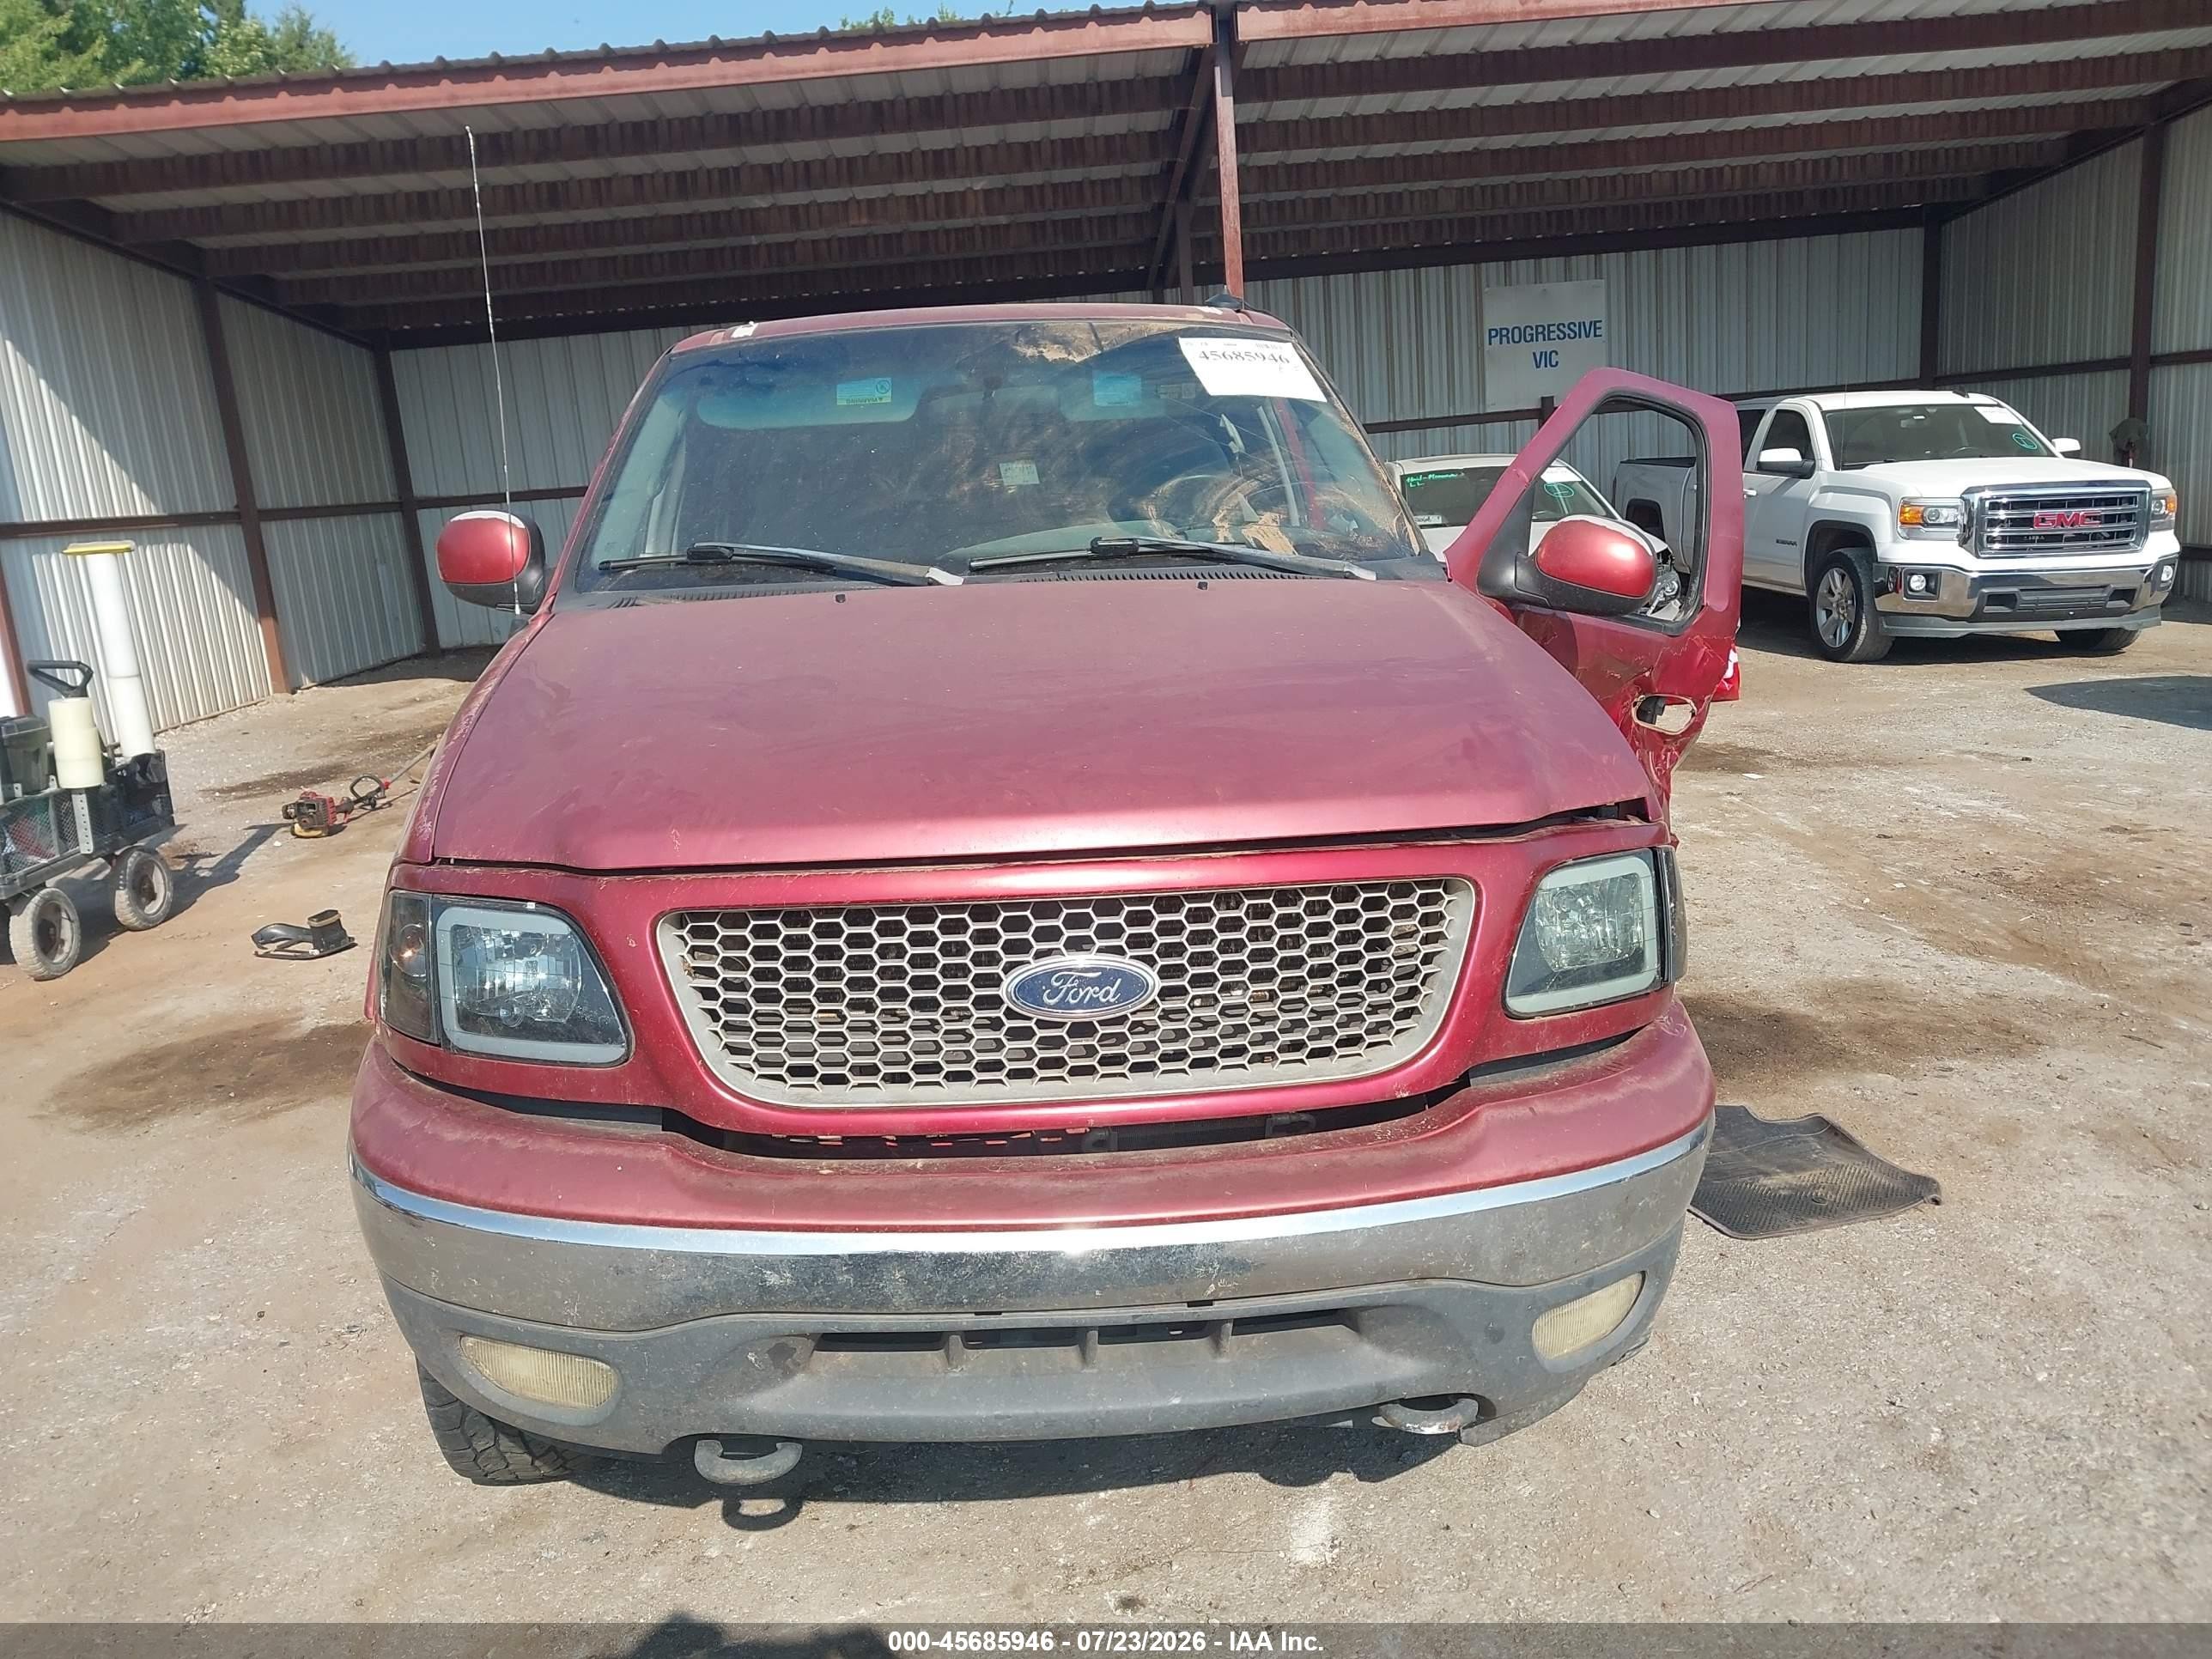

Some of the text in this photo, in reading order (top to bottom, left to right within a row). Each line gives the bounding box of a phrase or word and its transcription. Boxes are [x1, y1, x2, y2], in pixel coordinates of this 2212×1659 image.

[1488, 320, 1603, 345] PROGRESSIVE
[1532, 349, 1559, 368] VIC
[2033, 510, 2103, 529] GMC
[1042, 971, 1122, 1006] Ford
